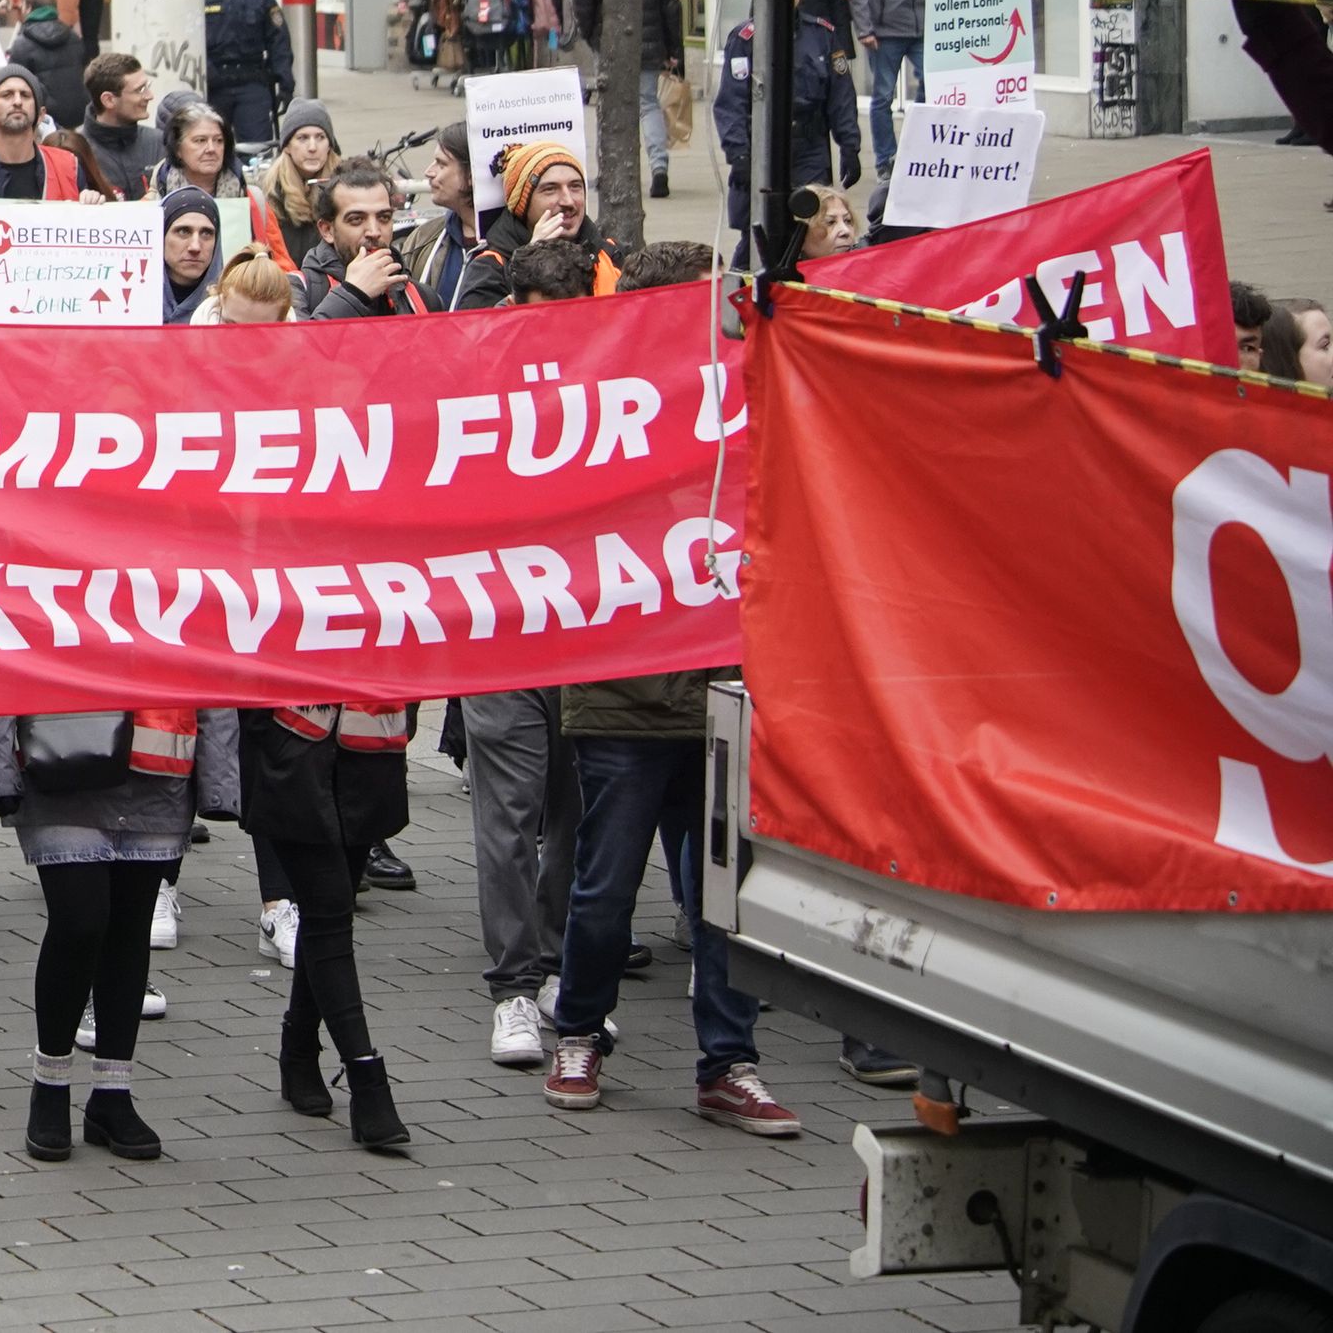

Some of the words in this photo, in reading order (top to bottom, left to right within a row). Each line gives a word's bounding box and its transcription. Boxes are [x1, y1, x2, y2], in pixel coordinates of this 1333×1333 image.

[934, 18, 955, 32] und
[958, 14, 1009, 31] Personal-
[934, 36, 991, 54] ausgleich!
[934, 86, 966, 107] vida
[995, 75, 1028, 104] gpa
[475, 100, 496, 113] kein
[498, 93, 547, 109] Abschluss
[548, 91, 576, 103] ohne:
[482, 119, 574, 139] Urabstimmung
[931, 123, 970, 146] Wir
[974, 126, 1014, 148] sind
[908, 157, 964, 180] mehr
[970, 160, 1020, 182] wert!
[17, 226, 154, 246] BETRIEBSRAT
[9, 287, 83, 315] LÖHNE
[424, 361, 662, 487] FÜR
